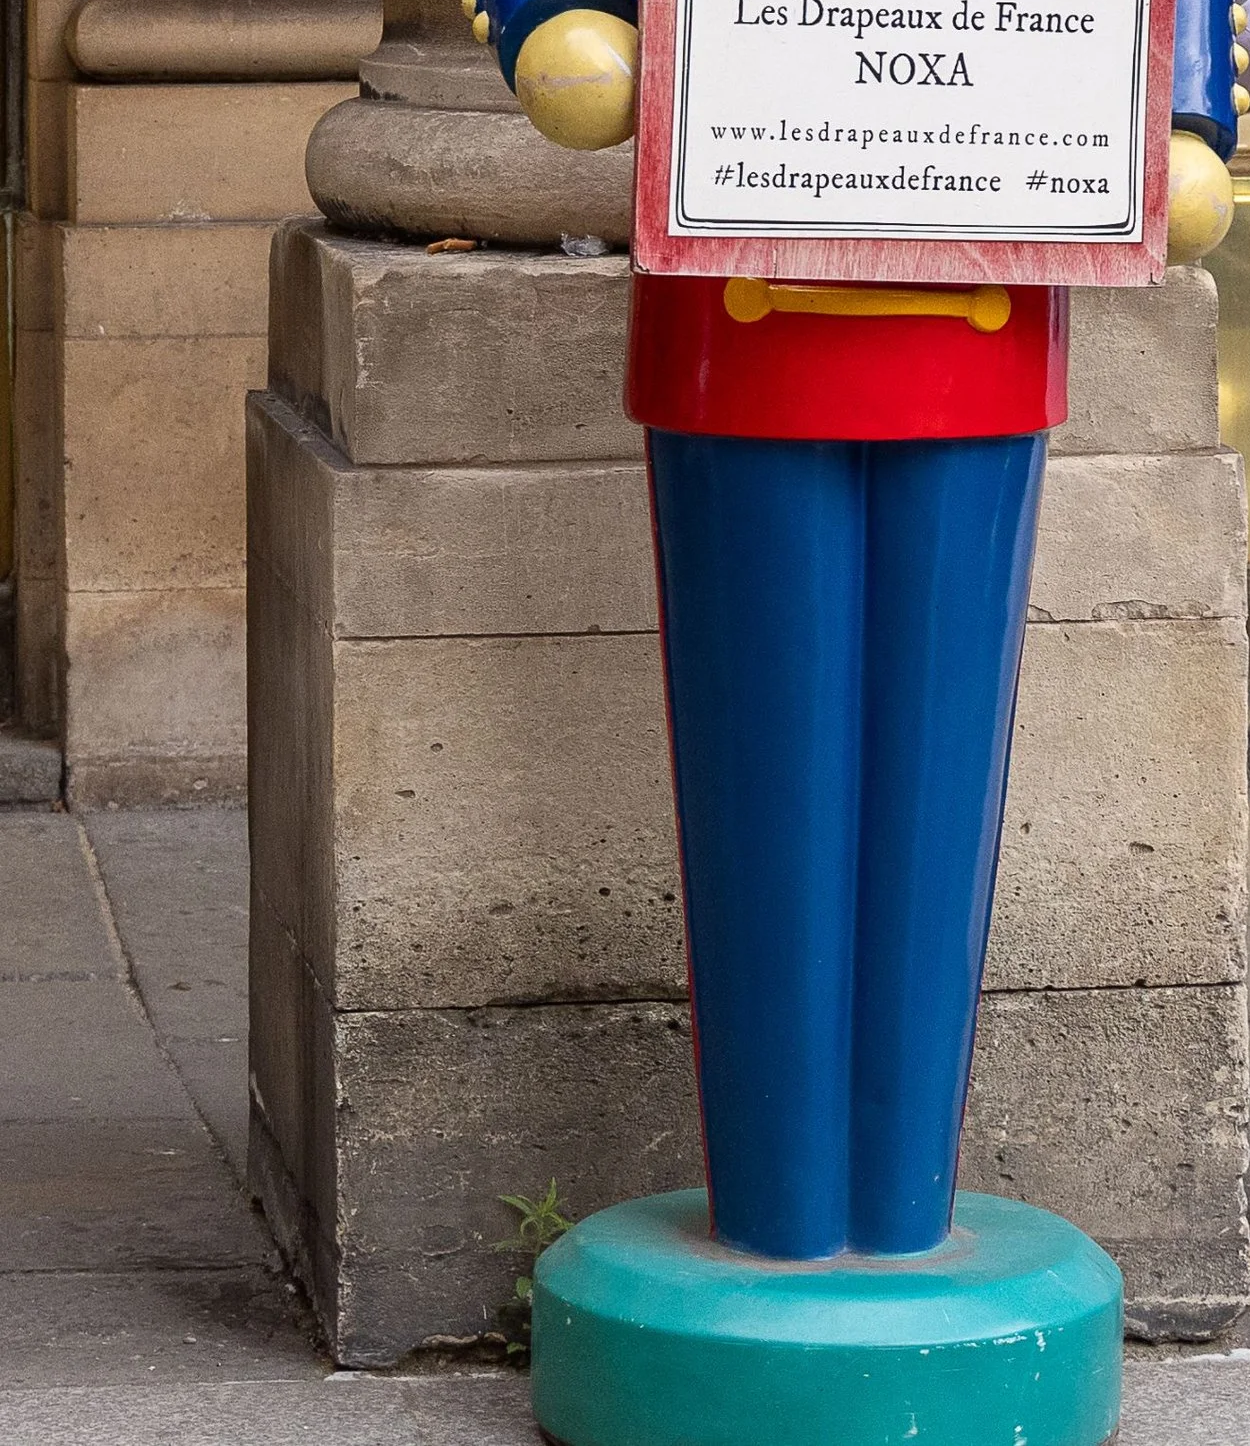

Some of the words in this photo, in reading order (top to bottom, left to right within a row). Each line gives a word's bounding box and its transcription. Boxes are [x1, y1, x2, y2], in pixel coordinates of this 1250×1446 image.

[952, 0, 985, 31] de
[994, 1, 1095, 34] France
[854, 51, 974, 87] NOXA
[710, 119, 1109, 150] www.lesdrapeauxdefrance.com
[714, 161, 1001, 198] #lesdrapeauxdefrance
[1025, 169, 1110, 194] #noxa
